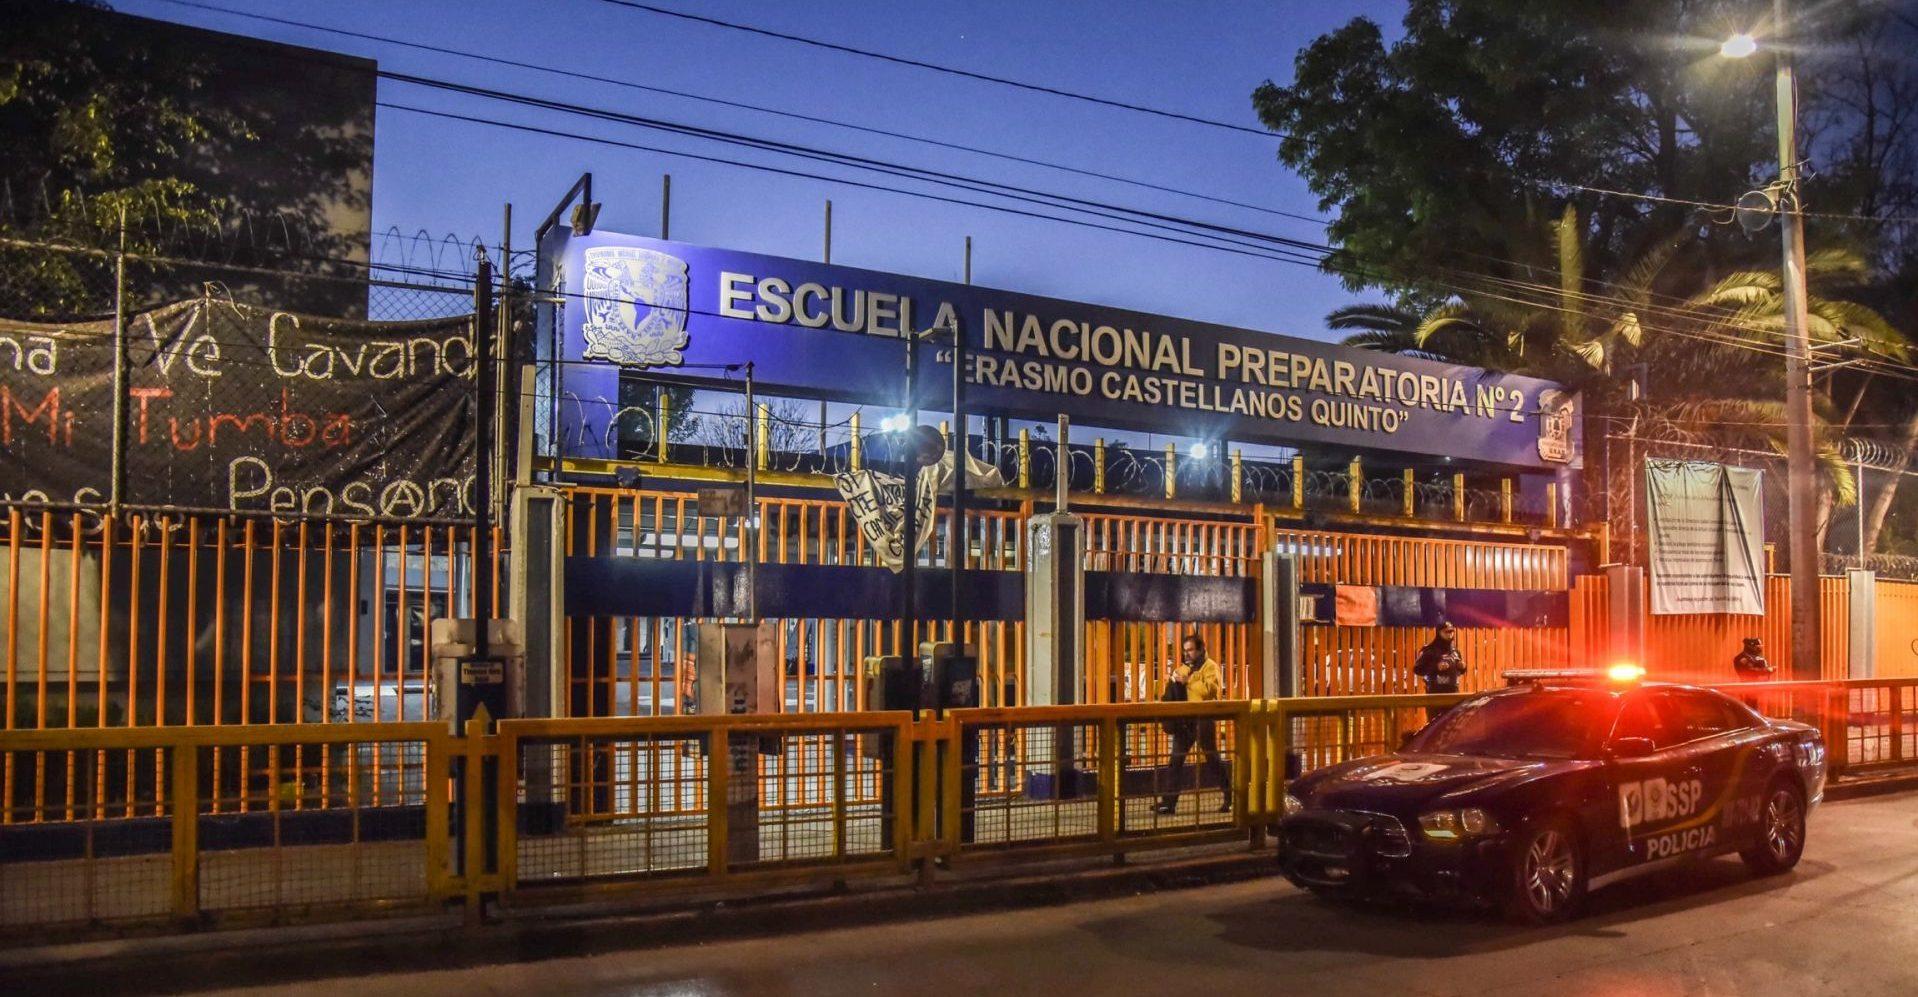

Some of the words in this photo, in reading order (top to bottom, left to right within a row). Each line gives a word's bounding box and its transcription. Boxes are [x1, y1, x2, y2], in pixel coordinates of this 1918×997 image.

[268, 311, 498, 381] Cavand
[719, 271, 959, 341] ESCUELA
[983, 307, 1204, 378] NACIONAL
[1218, 342, 1470, 415] PREPARATORIA
[1510, 388, 1525, 422] 2
[0, 384, 74, 448] Mi
[128, 386, 351, 452] Tumba
[1101, 372, 1303, 422] CASTELLANOS
[1667, 780, 1702, 818] SSP
[1647, 825, 1716, 861] POLICIA
